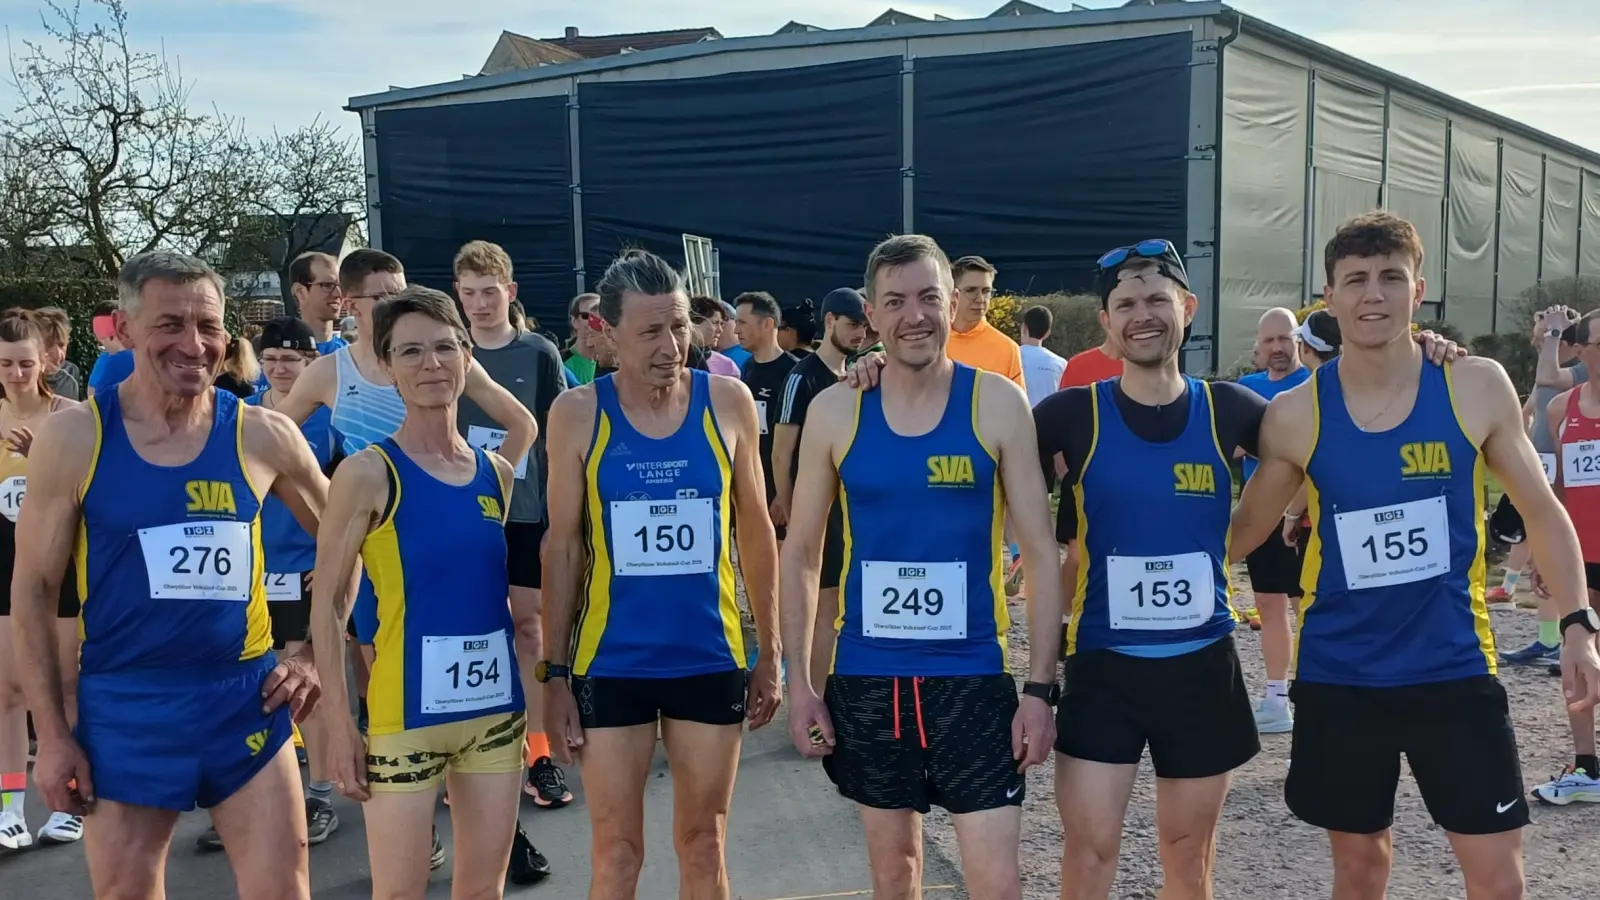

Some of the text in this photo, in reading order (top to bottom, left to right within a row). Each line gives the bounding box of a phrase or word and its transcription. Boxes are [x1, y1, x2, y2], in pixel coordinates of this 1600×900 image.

[636, 459, 689, 469] INTERSPORT
[926, 455, 976, 483] SVA
[1400, 441, 1452, 475] SVA
[638, 469, 681, 478] LANGE
[1173, 463, 1216, 492] SVA
[185, 480, 237, 514] SVA
[650, 505, 677, 514] IGZ
[1374, 509, 1404, 523] IGZ
[183, 526, 214, 535] IGZ
[634, 524, 694, 553] 150
[1361, 527, 1428, 563] 155
[169, 546, 231, 575] 276
[898, 567, 926, 577] IGZ
[1145, 560, 1173, 571] IGZ
[882, 587, 944, 616] 249
[1130, 579, 1192, 608] 153
[463, 639, 488, 651] IGZ
[445, 657, 500, 689] 154
[245, 729, 269, 756] SV
